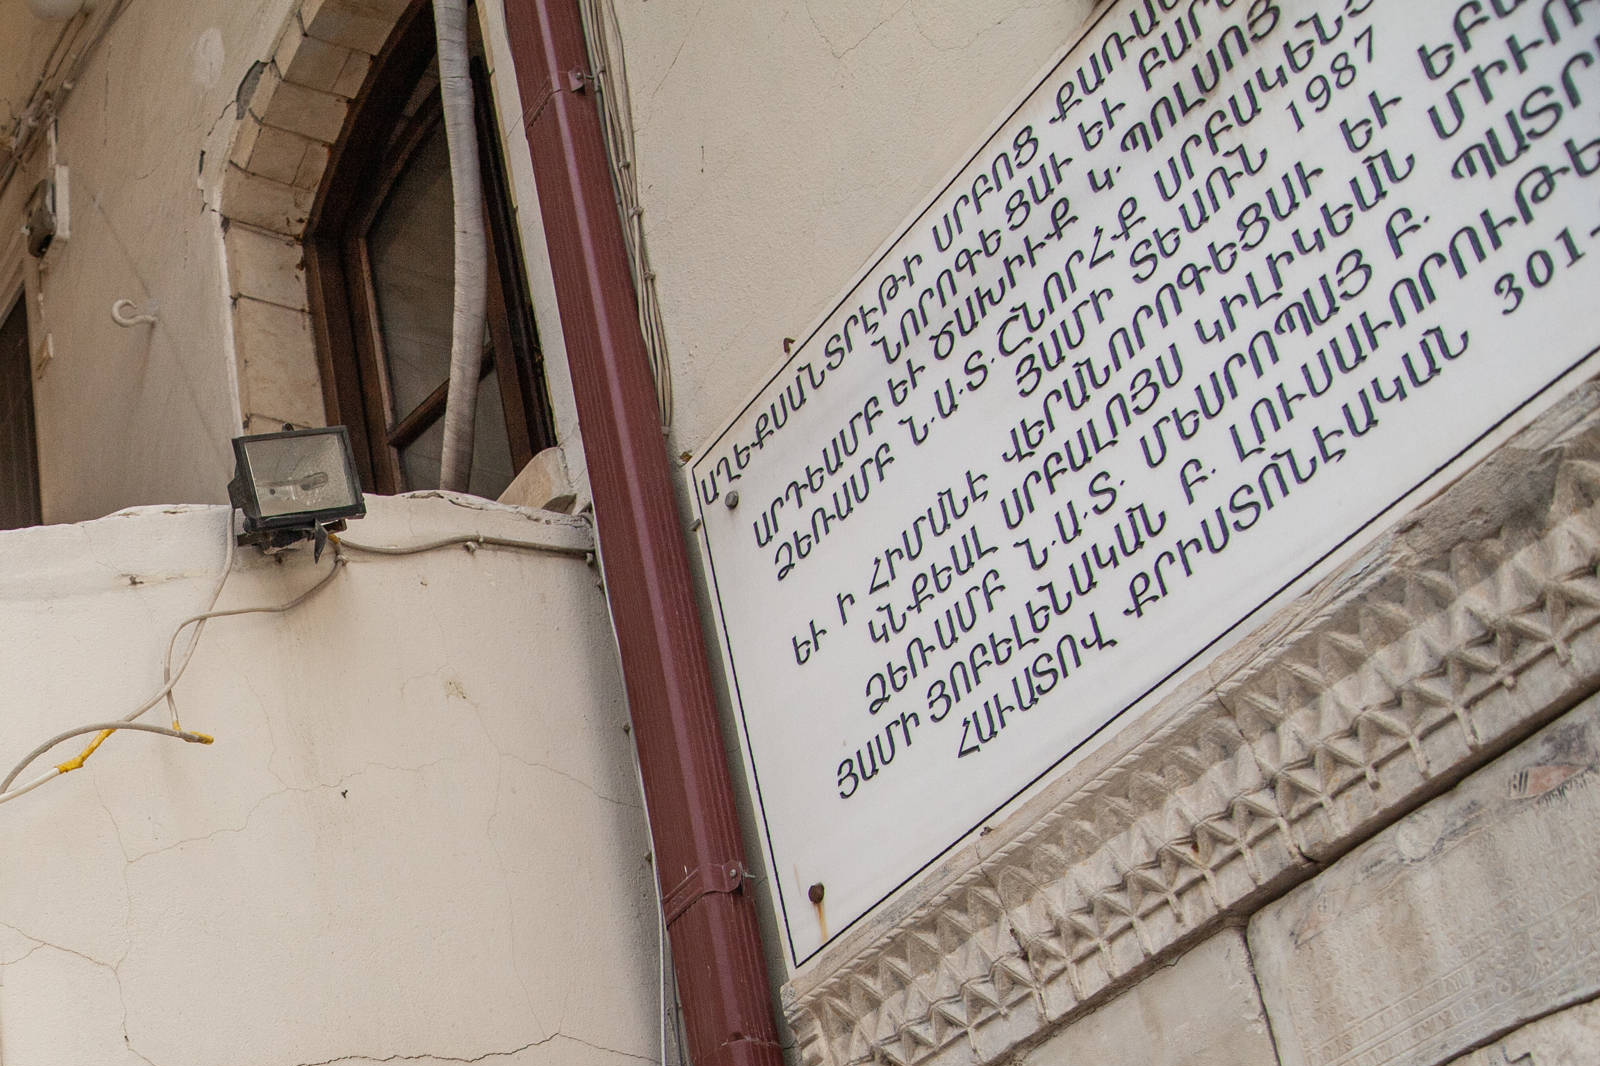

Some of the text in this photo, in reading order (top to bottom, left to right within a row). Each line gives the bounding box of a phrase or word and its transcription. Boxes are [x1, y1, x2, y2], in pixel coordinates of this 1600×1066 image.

[701, 254, 923, 505] ԱՂԵՔՍԱՆՏՐԷԹԻ
[932, 125, 1039, 253] ՍՐԲՈՑ
[870, 0, 1237, 364] ՆՈՐՈԳԵՑԱՒ ԵՒ ԲԱՐ
[1016, 25, 1373, 398] ՅԱՄԻ ՏԵԱՌՆ 1987
[753, 396, 883, 548] ԱՐԴԵԱՄԲ
[887, 358, 926, 407] ԵՒ
[928, 197, 1079, 360] ԾԱԽԻՒՔ
[775, 442, 895, 581] ՁԵՌԱՄԲ
[792, 619, 827, 665] ԵՒ
[837, 593, 855, 627] Ի
[869, 470, 988, 595] ՀԻՄԱՆԷ
[1002, 161, 1324, 463] ՎԵՐԱՆՈՐՈԳԵՑԱՒ
[1339, 91, 1402, 153] ԵՒ
[866, 34, 1600, 715] ՁԵՌԱՄԲ Ն.Ա.Տ. ՄԵՍՐՈՊԱՅ Բ. ՊԱՏՐ
[868, 525, 999, 643] ԿՆՔԵԱԼ
[1000, 342, 1183, 530] ՍՐԲԱԼՈՅՍ
[1194, 149, 1415, 344] ԿԻԼԻԿԵԱՆ
[958, 611, 1118, 758] ՀԱՒԱՏՈՎ
[1123, 325, 1469, 618] ՔՐԻՍՏՈՆԷԱԿԱՆ
[837, 712, 920, 799] ՅԱՄԻ
[927, 502, 1166, 723] ՅՈԲԵԼԵՆԱԿԱՆ
[1180, 459, 1216, 506] Բ.
